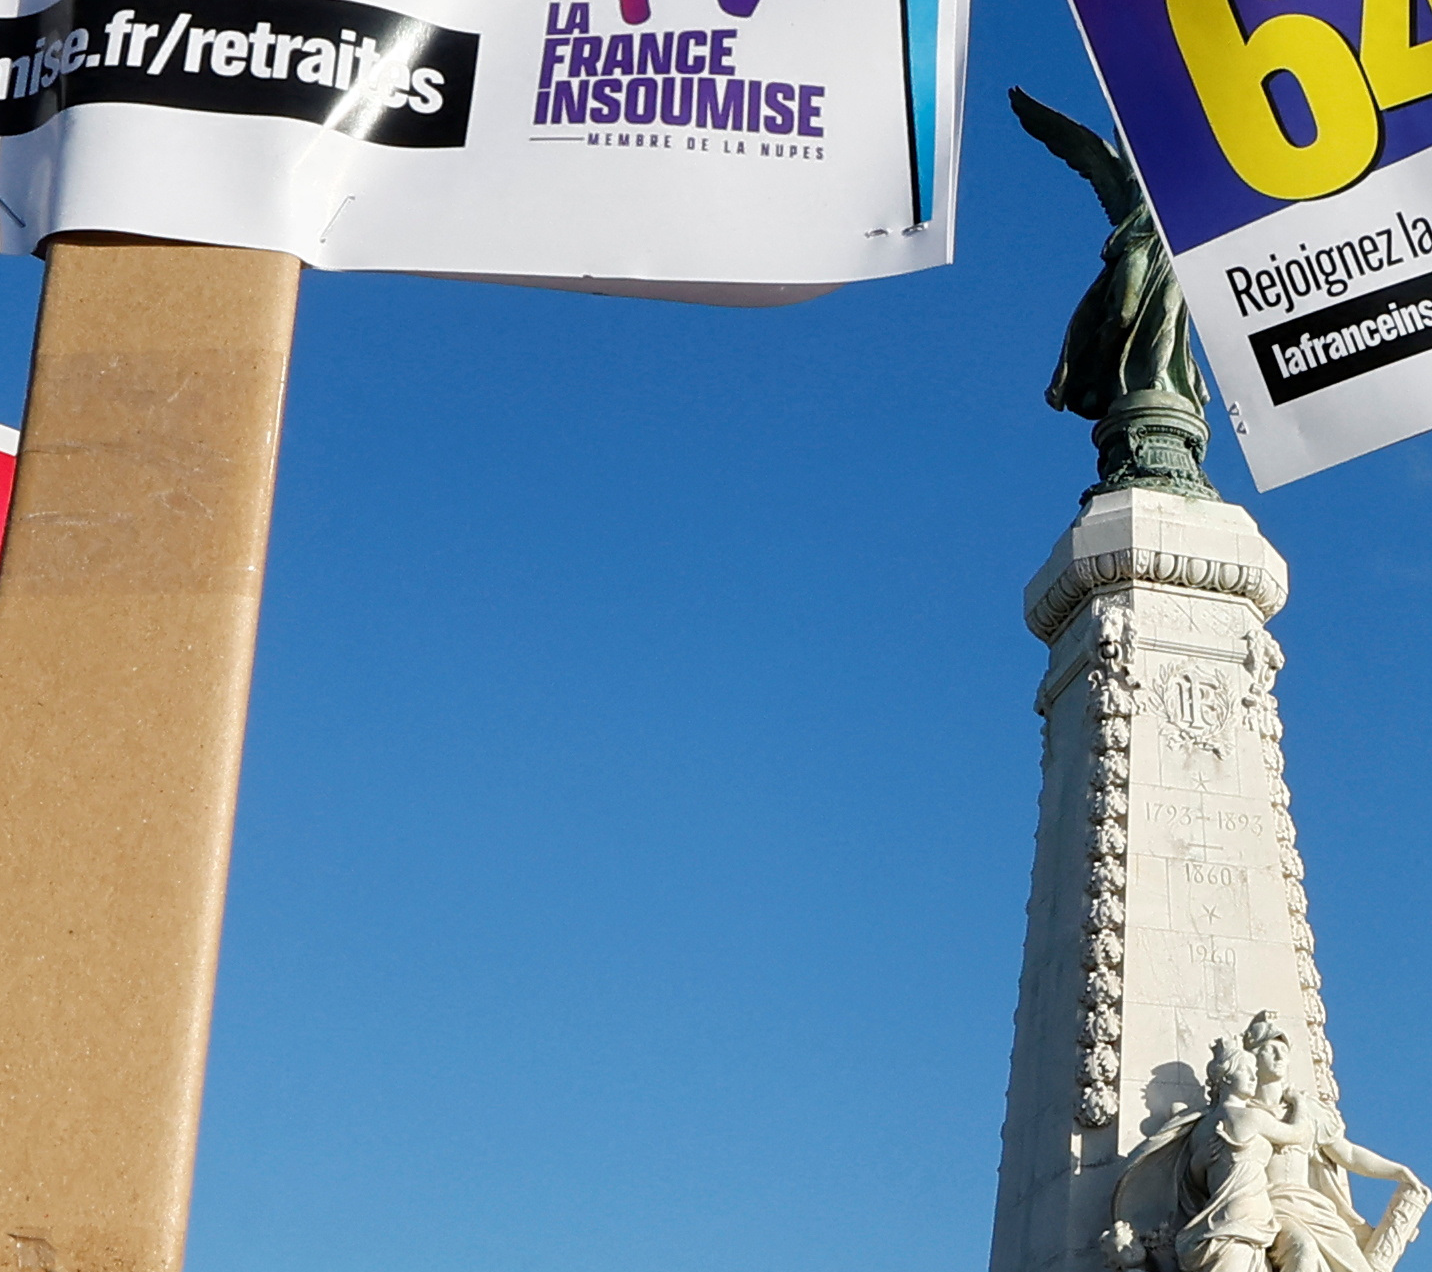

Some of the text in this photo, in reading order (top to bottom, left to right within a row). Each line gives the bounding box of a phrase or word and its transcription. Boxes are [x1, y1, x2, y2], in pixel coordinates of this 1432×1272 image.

[546, 2, 590, 35] LA
[538, 28, 737, 91] FRANCE
[533, 76, 825, 138] INSOUMISE
[588, 133, 825, 160] MEMBRE DE LA NUPES
[1226, 229, 1404, 317] Rejoignez
[1184, 863, 1231, 886] 1860
